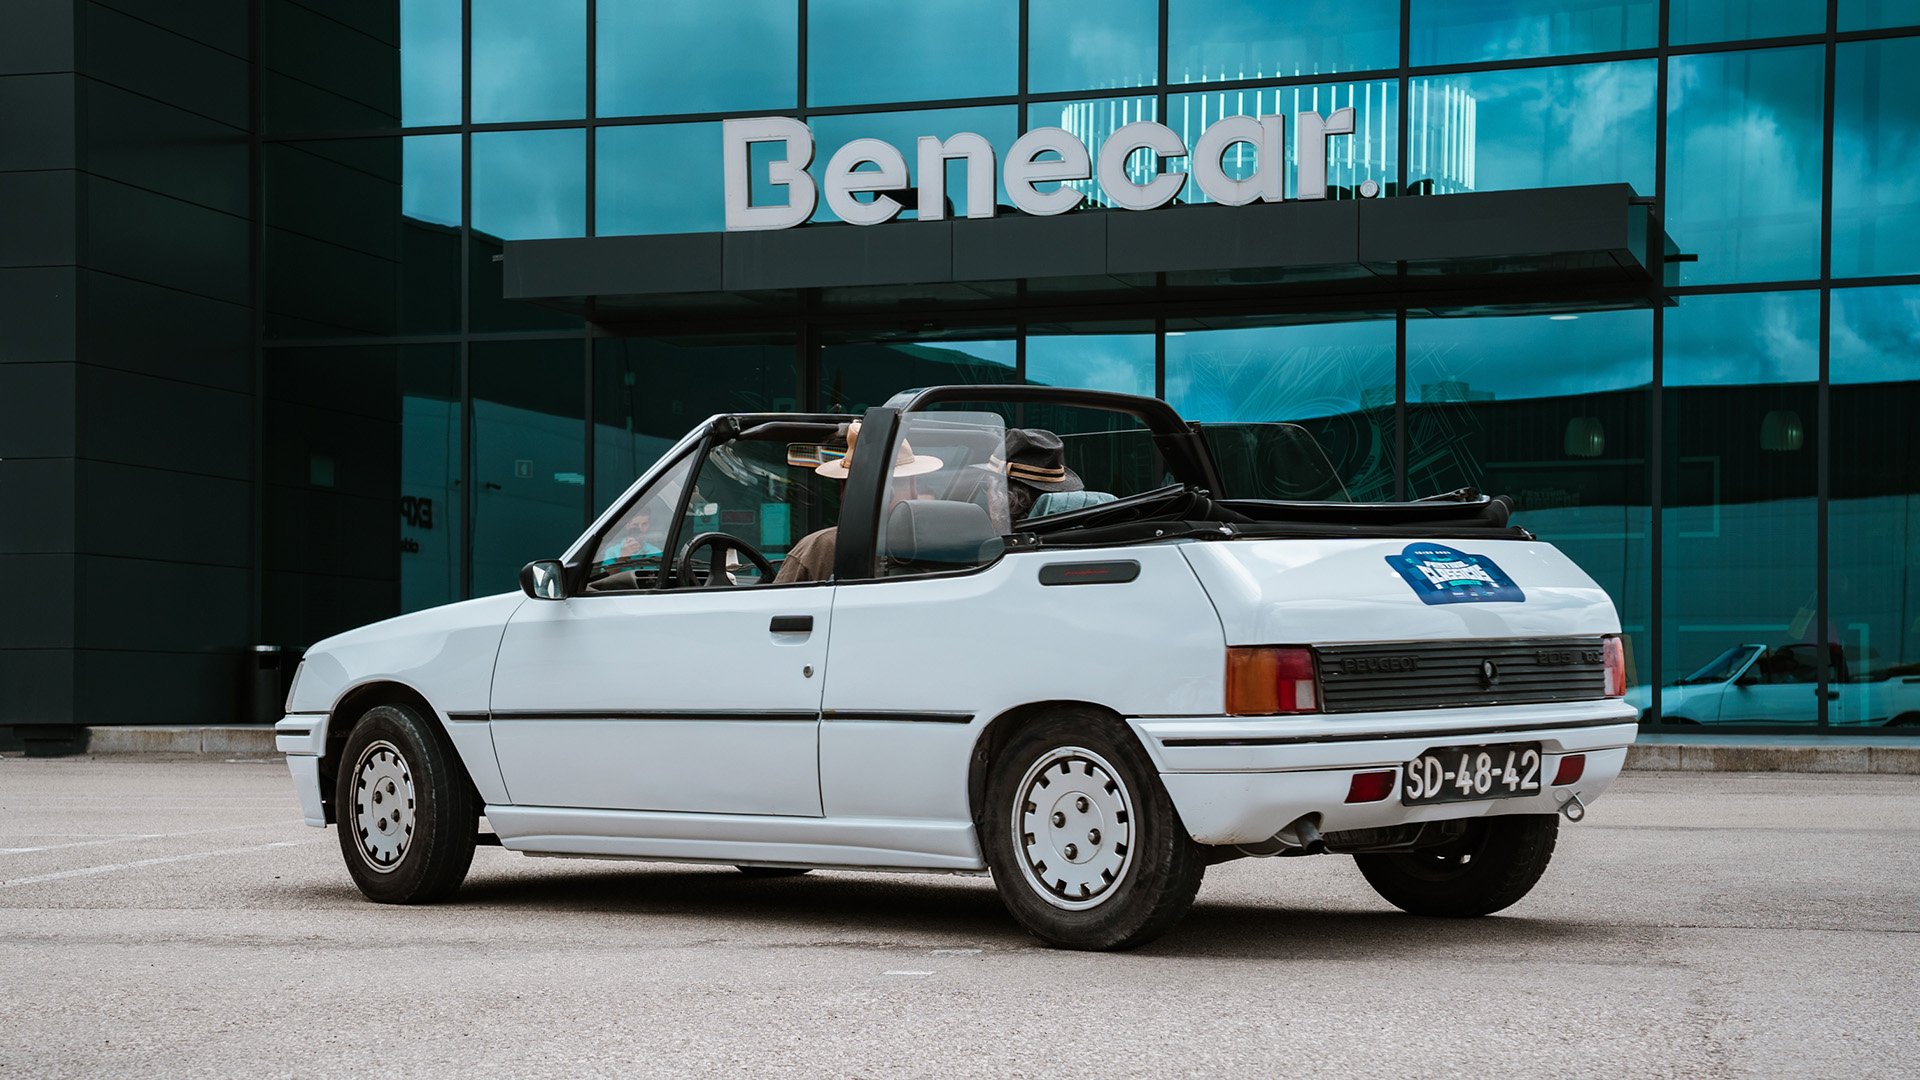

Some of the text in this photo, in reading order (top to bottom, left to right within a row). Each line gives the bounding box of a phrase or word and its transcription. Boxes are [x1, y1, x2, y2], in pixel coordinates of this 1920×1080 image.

[1343, 656, 1419, 672] PEUGEOT
[1537, 650, 1571, 665] 205
[1406, 749, 1539, 800] SD-48-42
